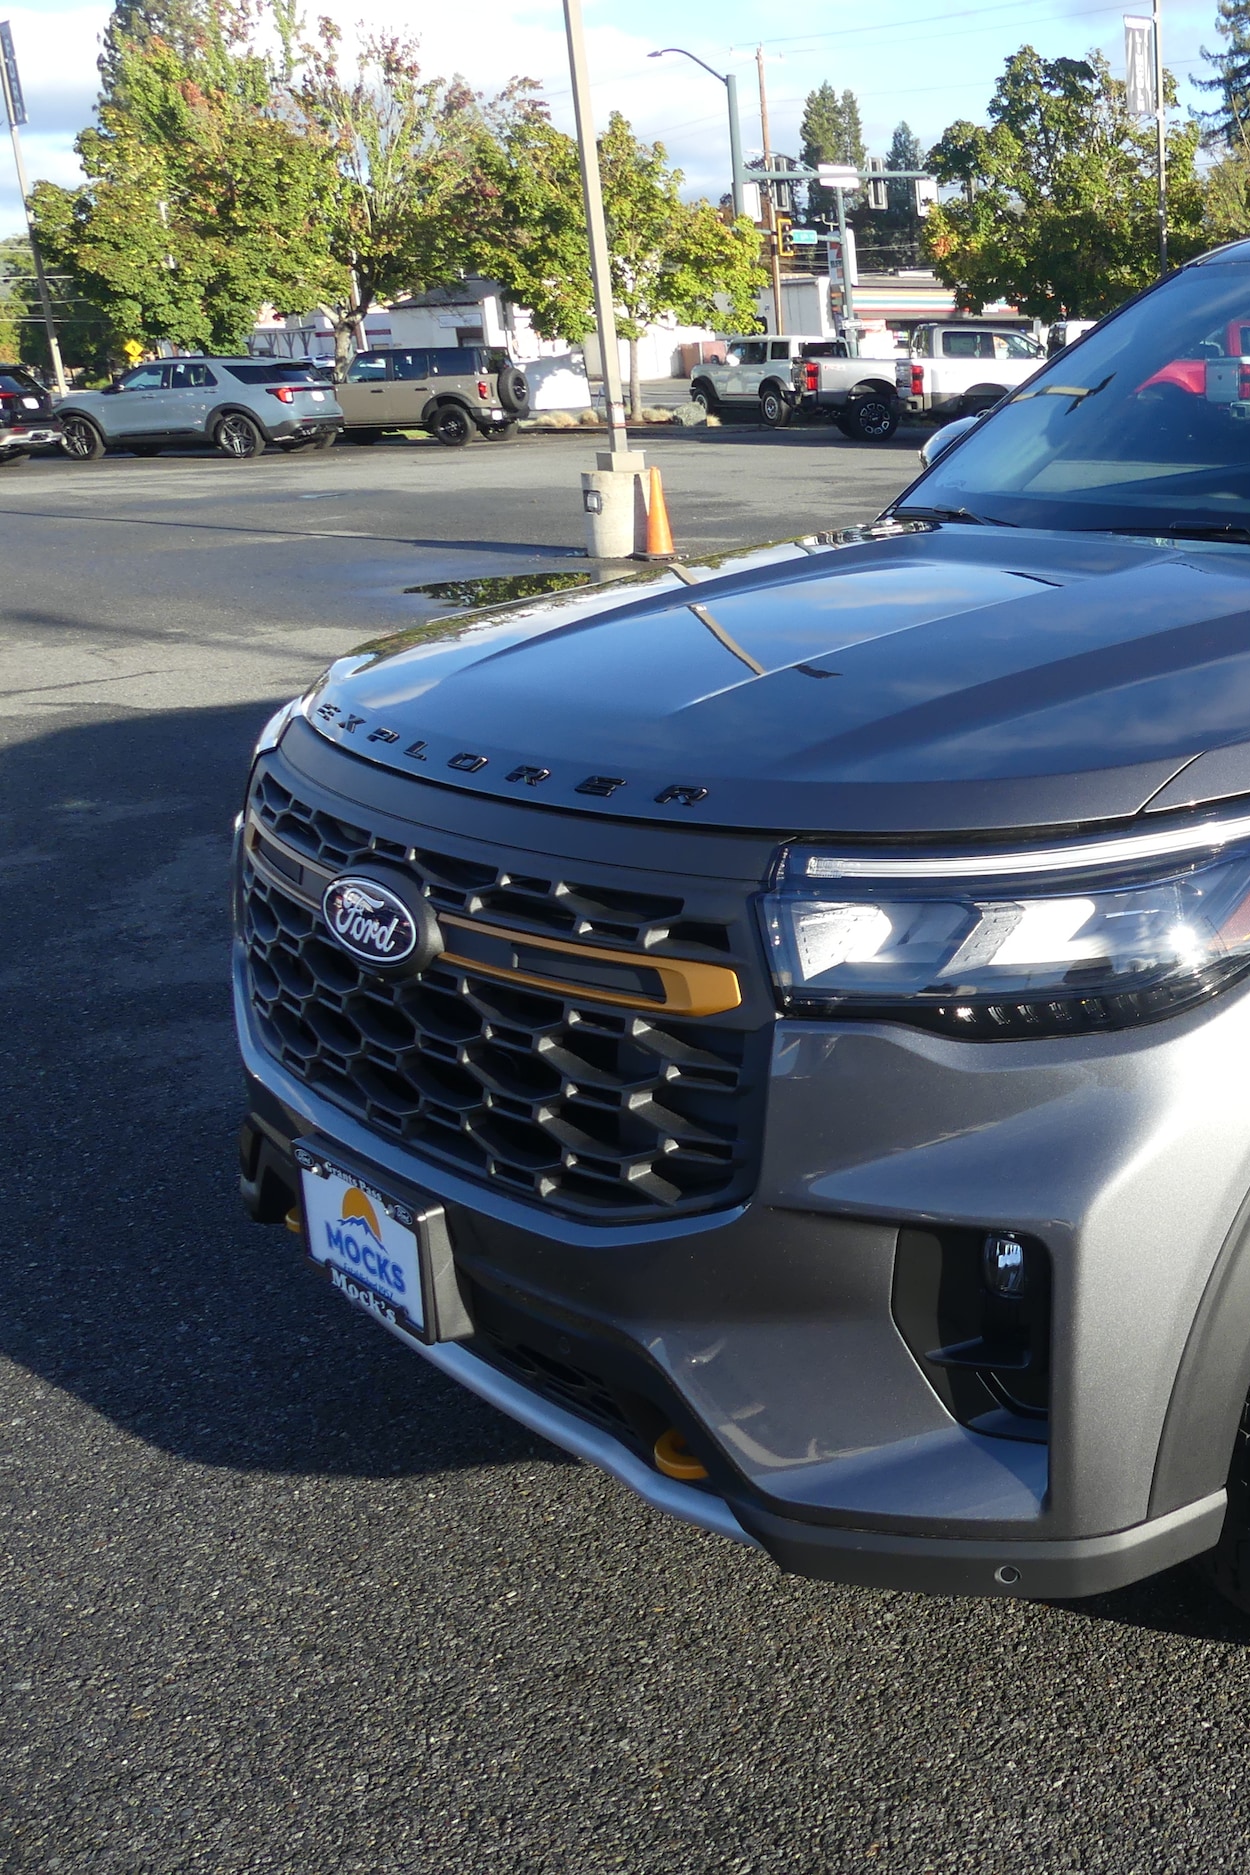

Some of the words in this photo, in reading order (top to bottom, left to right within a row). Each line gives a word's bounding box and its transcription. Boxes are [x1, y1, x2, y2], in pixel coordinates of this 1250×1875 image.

[4, 39, 22, 120] FORD
[1135, 30, 1145, 111] LINCOLN
[315, 702, 709, 807] EXPLORER
[335, 887, 400, 953] Ford
[324, 1161, 358, 1188] Grants
[358, 1179, 383, 1202] Pass
[324, 1221, 406, 1294] MOCKS
[330, 1266, 397, 1324] Mock's
